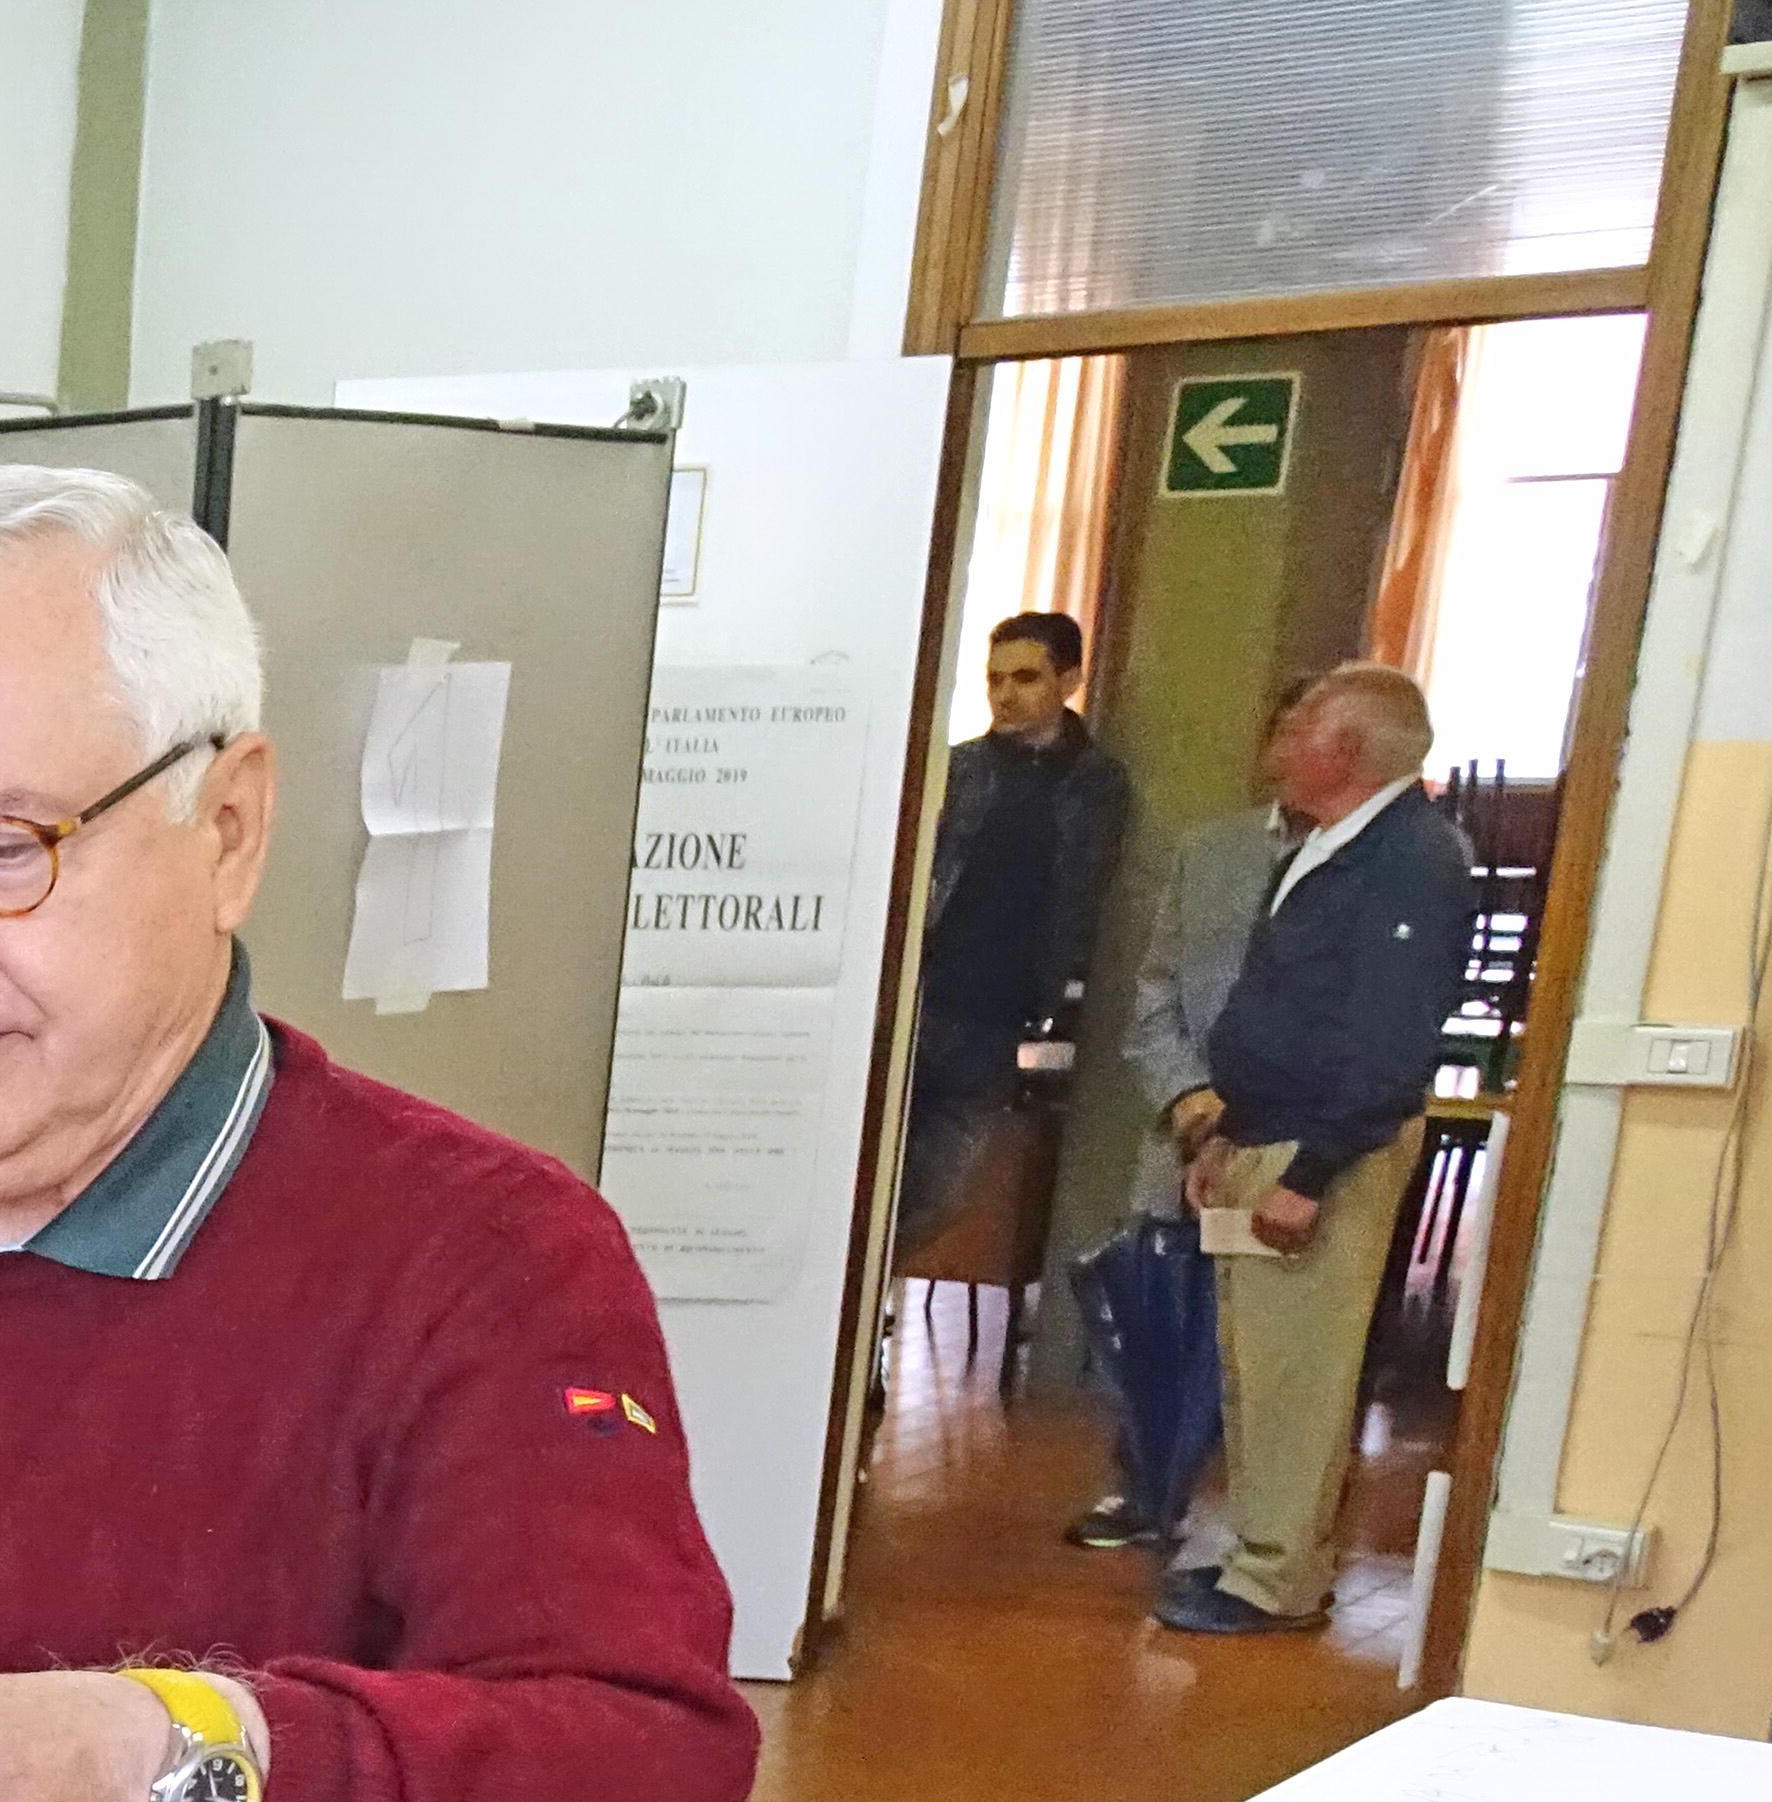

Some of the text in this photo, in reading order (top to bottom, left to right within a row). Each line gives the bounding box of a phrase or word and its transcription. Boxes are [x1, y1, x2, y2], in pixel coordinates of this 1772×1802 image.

[650, 705, 847, 724] PARLAMENTO EUROPEO
[665, 737, 719, 754] ITALIA
[715, 769, 748, 784] 2019
